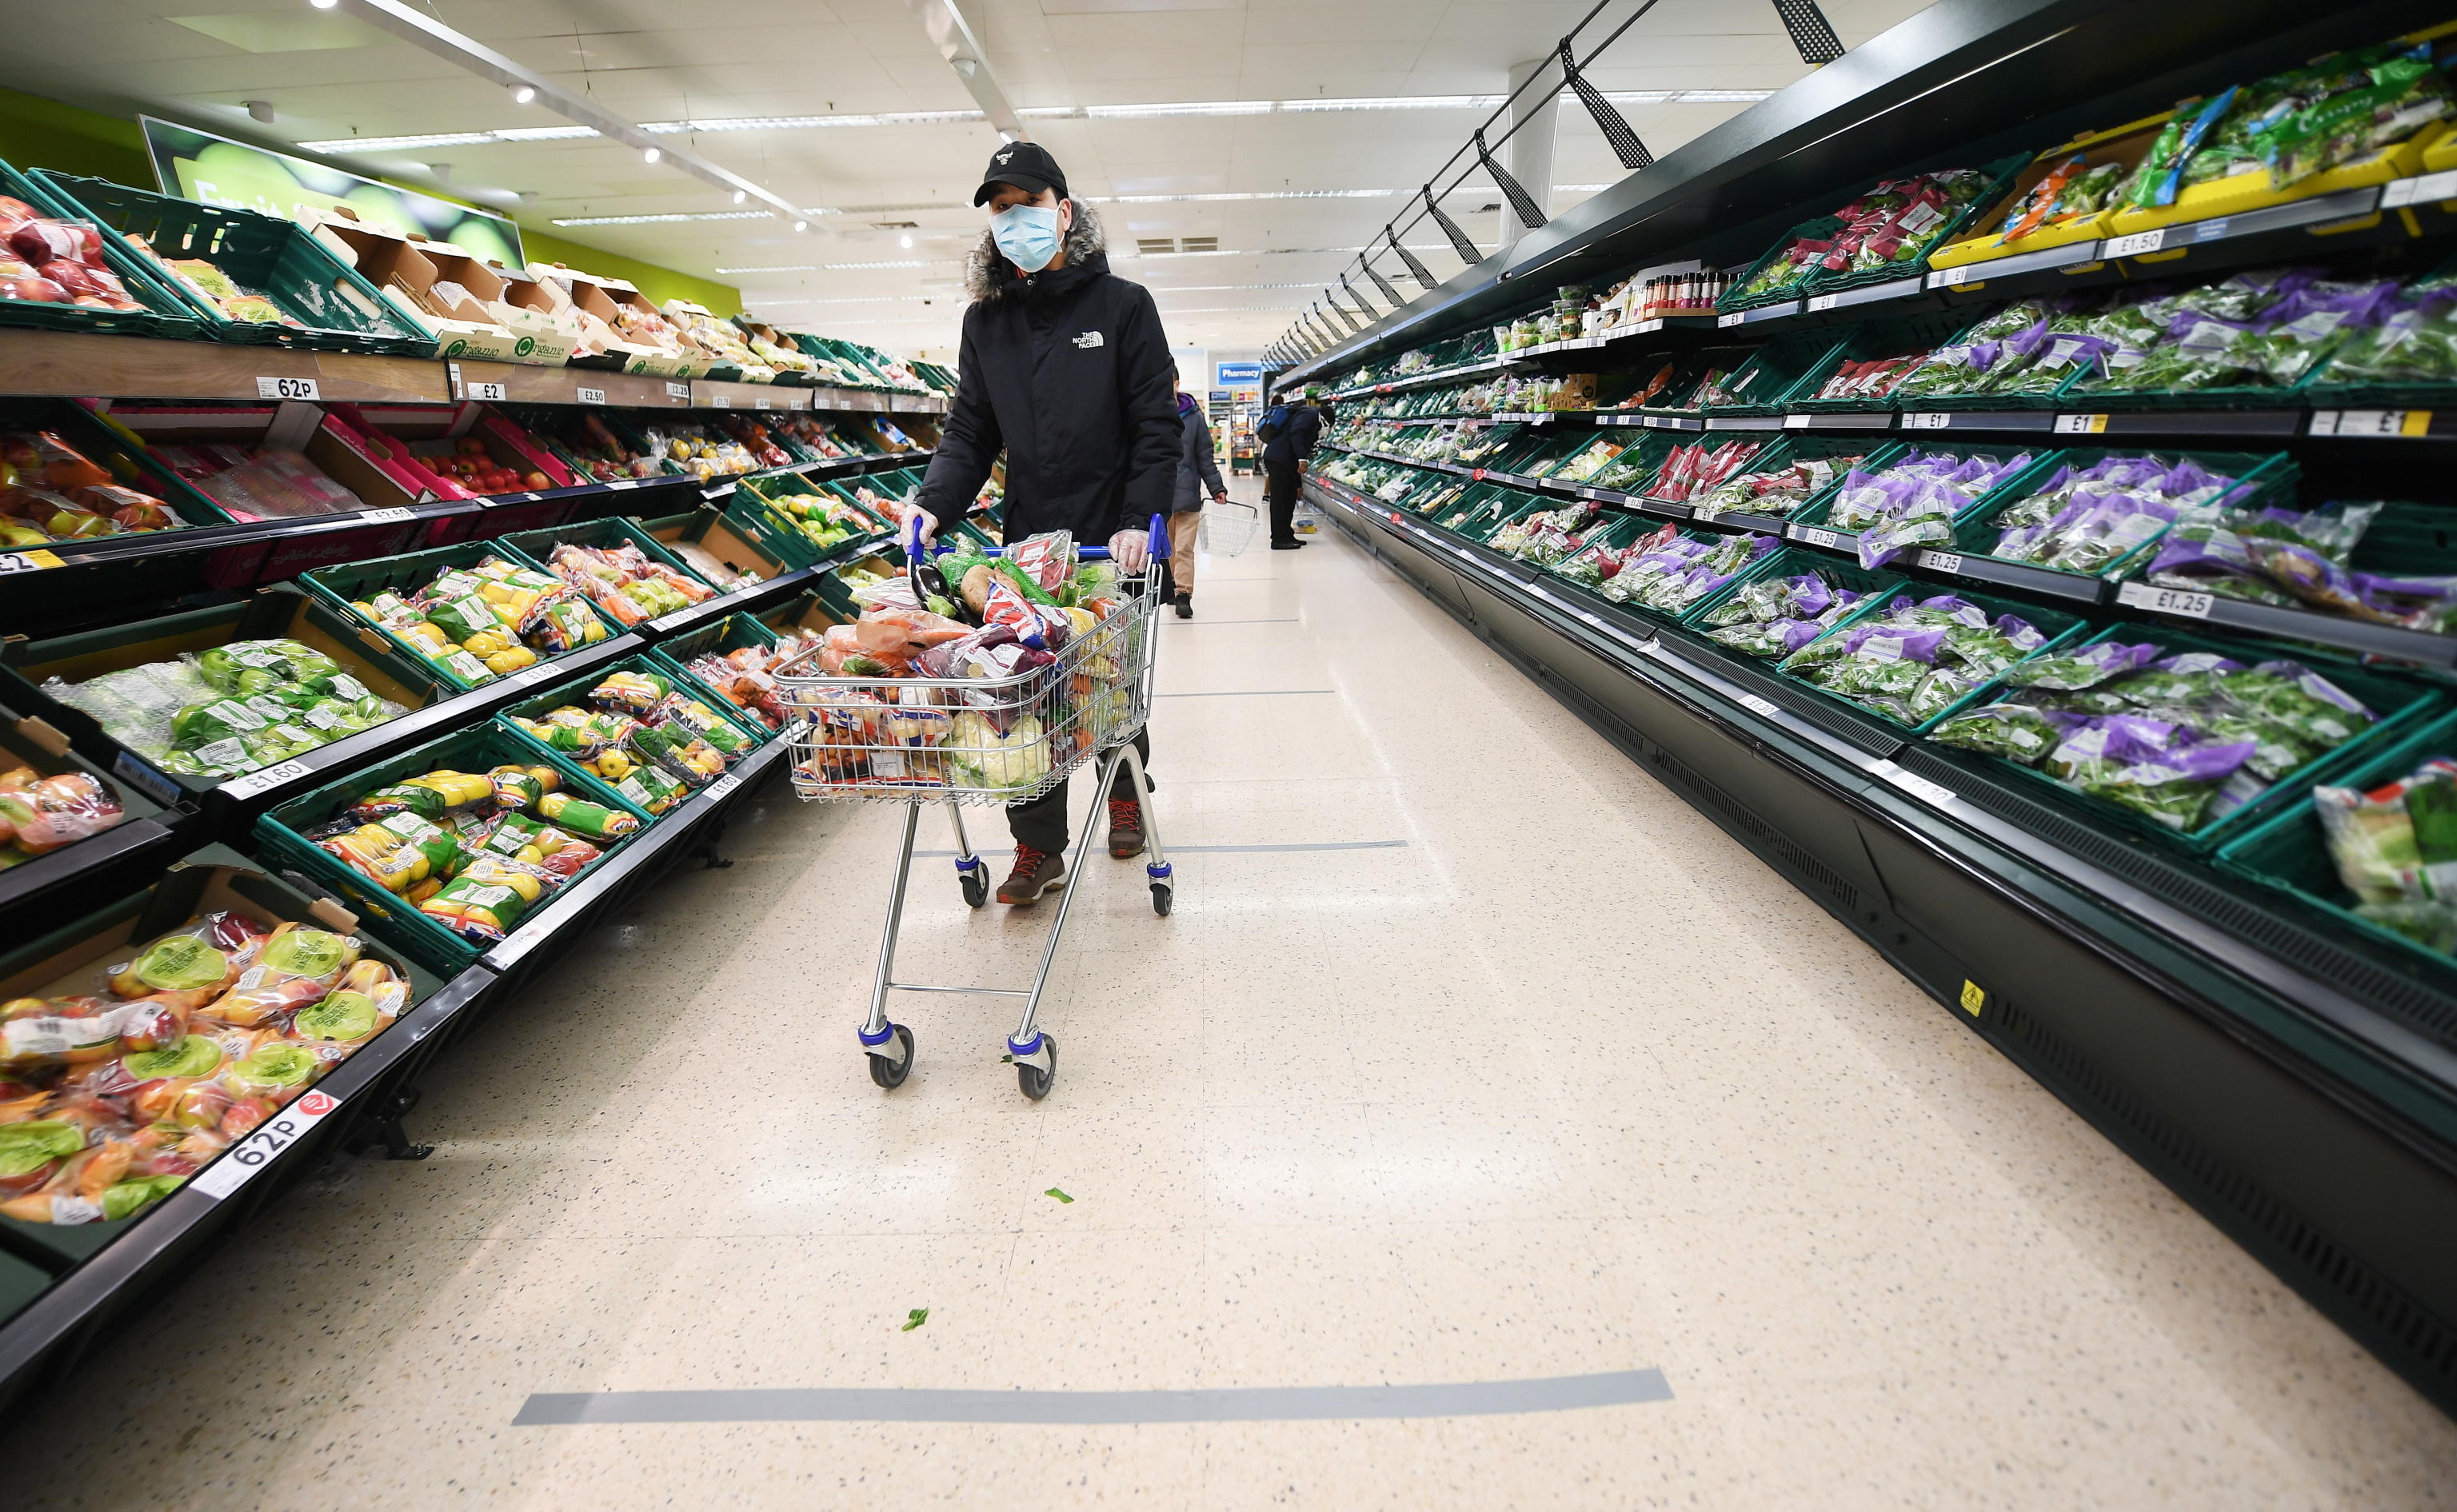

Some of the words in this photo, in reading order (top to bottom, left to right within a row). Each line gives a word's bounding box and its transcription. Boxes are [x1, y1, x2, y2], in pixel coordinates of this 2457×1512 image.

[2120, 233, 2159, 253] £1.50
[1820, 296, 1831, 309] £1
[1731, 314, 1739, 325] £1
[514, 336, 565, 357] Organic
[1221, 369, 1260, 377] Pharmacy
[278, 378, 311, 398] 62p
[484, 384, 497, 399] £2
[672, 384, 688, 396] £2.25
[585, 390, 604, 402] £2.50
[1929, 414, 1942, 428] £1
[2072, 415, 2090, 431] £1
[1630, 497, 1642, 508] £1.25
[1813, 533, 1835, 545] £1.25
[1929, 553, 1959, 570] £1.25
[2157, 592, 2207, 612] £1.25
[526, 665, 558, 680] £1.60
[1748, 700, 1775, 714] £1.30
[246, 764, 303, 788] £1.60
[713, 777, 737, 794] £1.60
[233, 1119, 295, 1166] 62p
